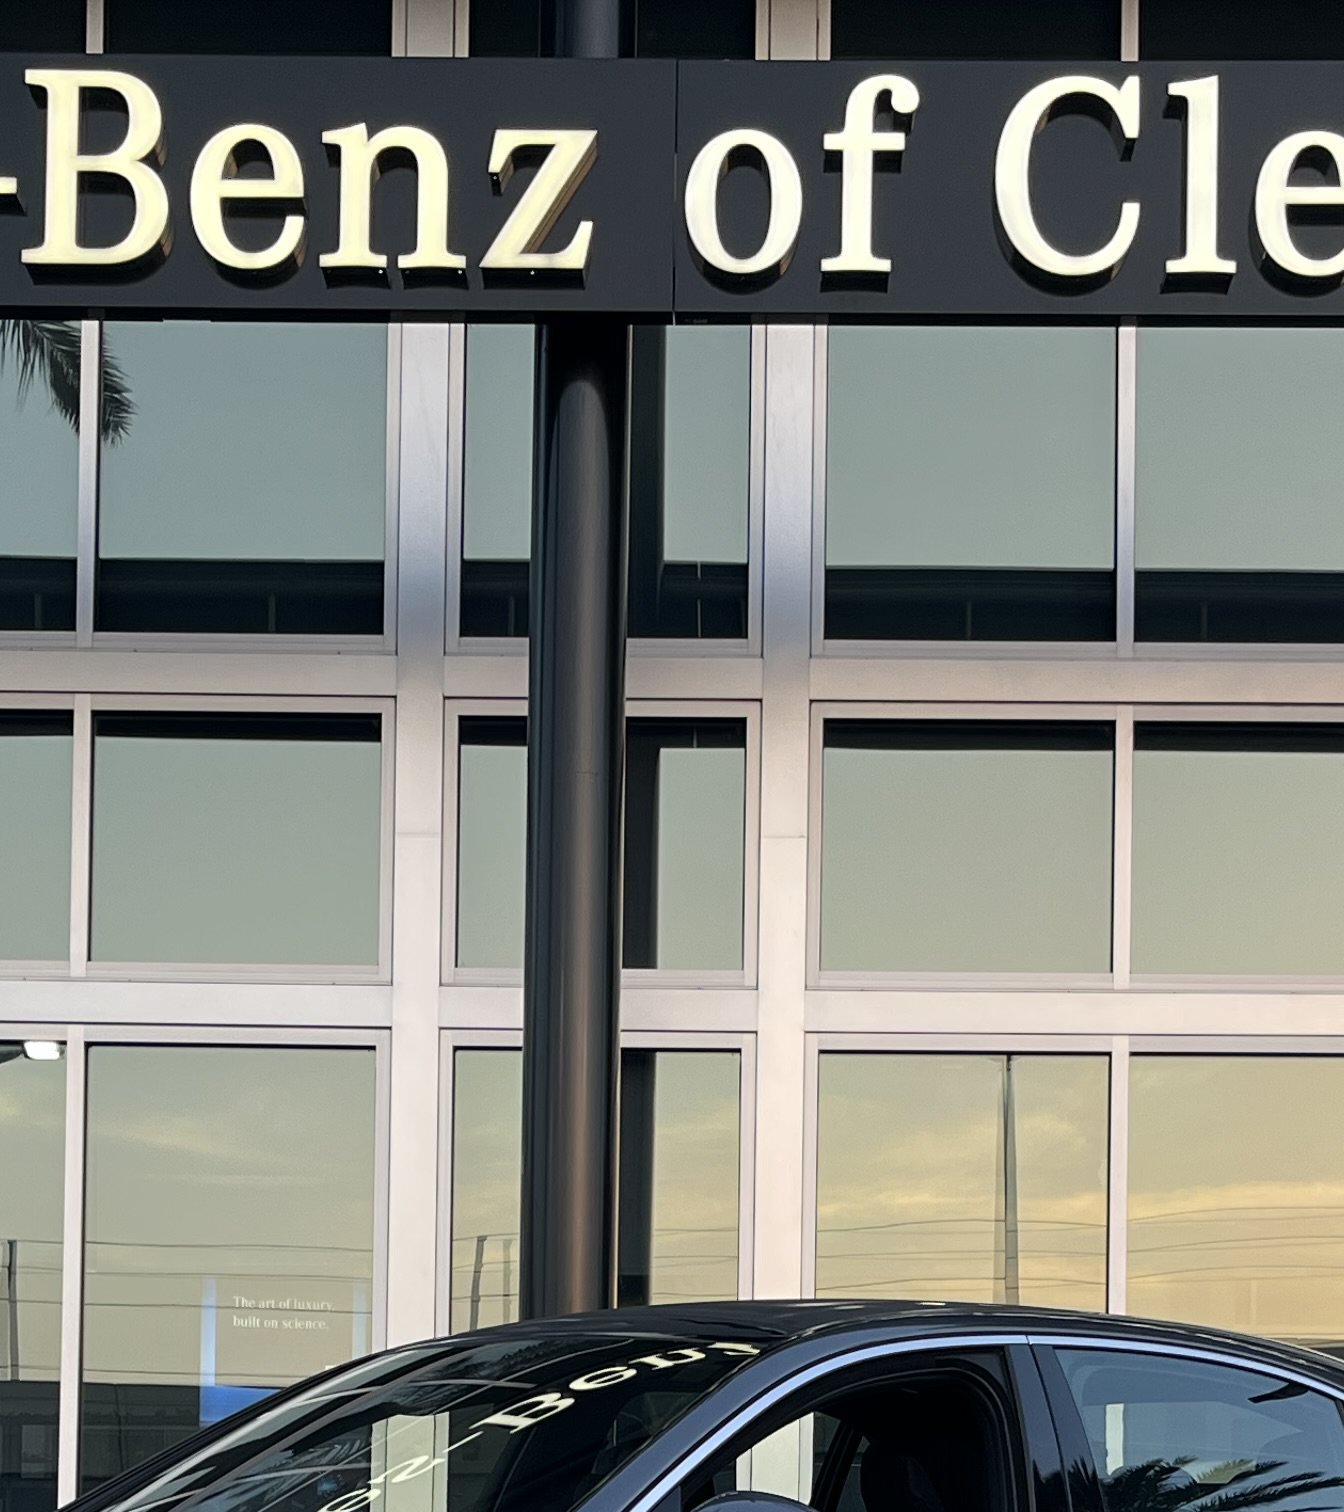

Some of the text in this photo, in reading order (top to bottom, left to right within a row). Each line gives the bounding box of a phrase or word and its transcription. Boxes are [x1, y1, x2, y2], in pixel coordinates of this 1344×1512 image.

[686, 76, 919, 276] of
[233, 1296, 256, 1309] The
[258, 1299, 275, 1310] art
[278, 1298, 292, 1310] of
[233, 1315, 329, 1331] built on science.
